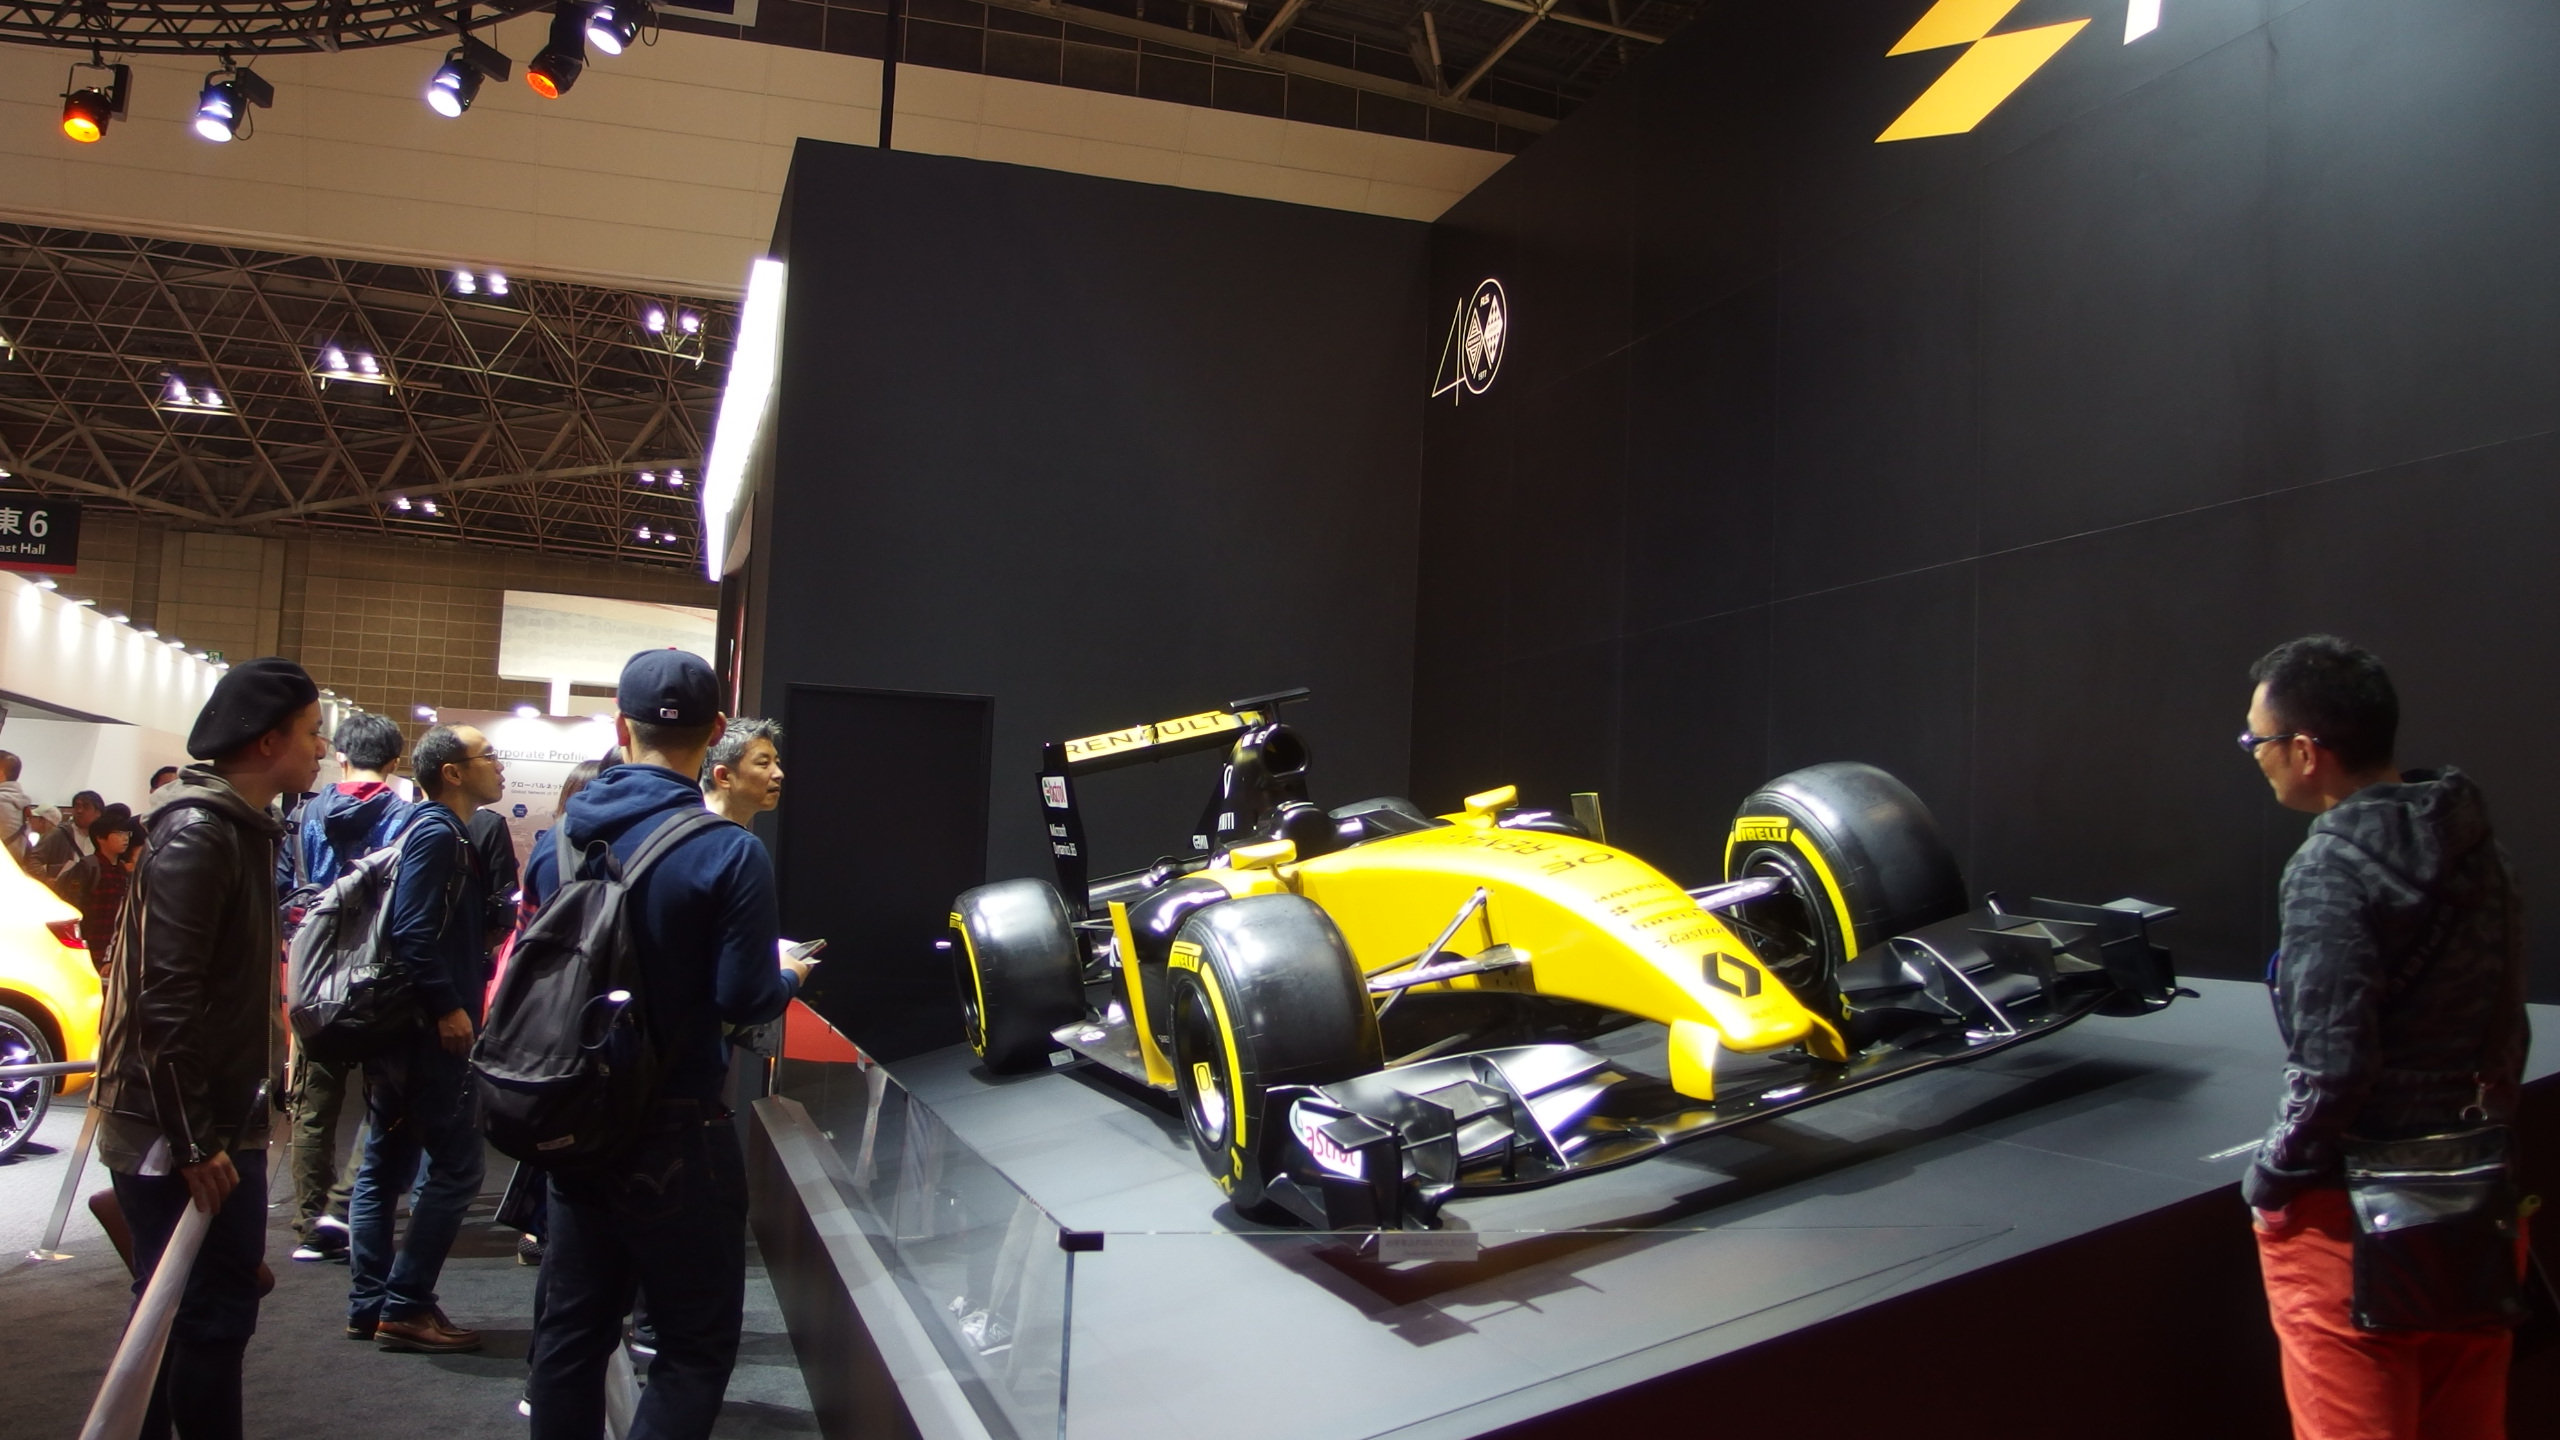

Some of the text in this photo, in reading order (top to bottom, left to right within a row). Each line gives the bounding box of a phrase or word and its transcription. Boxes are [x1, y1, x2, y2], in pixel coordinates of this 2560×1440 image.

[0, 542, 46, 555] ast Hall
[493, 749, 589, 761] orporate Profile
[1735, 816, 1789, 843] PIRELLI
